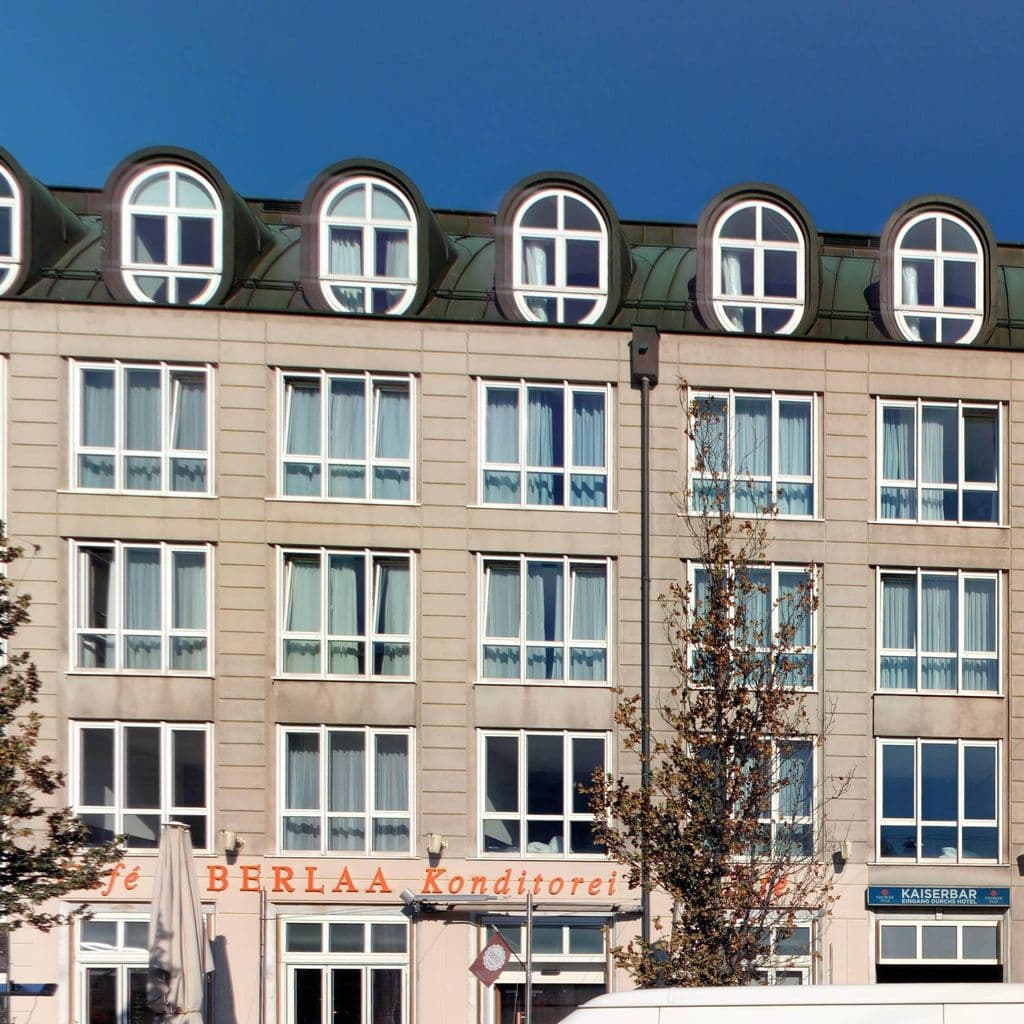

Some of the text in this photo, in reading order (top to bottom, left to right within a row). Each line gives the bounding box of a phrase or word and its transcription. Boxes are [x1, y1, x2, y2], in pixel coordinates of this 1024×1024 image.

[206, 864, 392, 894] BERLAA
[421, 867, 617, 896] Konditorei
[901, 889, 977, 899] KAISERBAR
